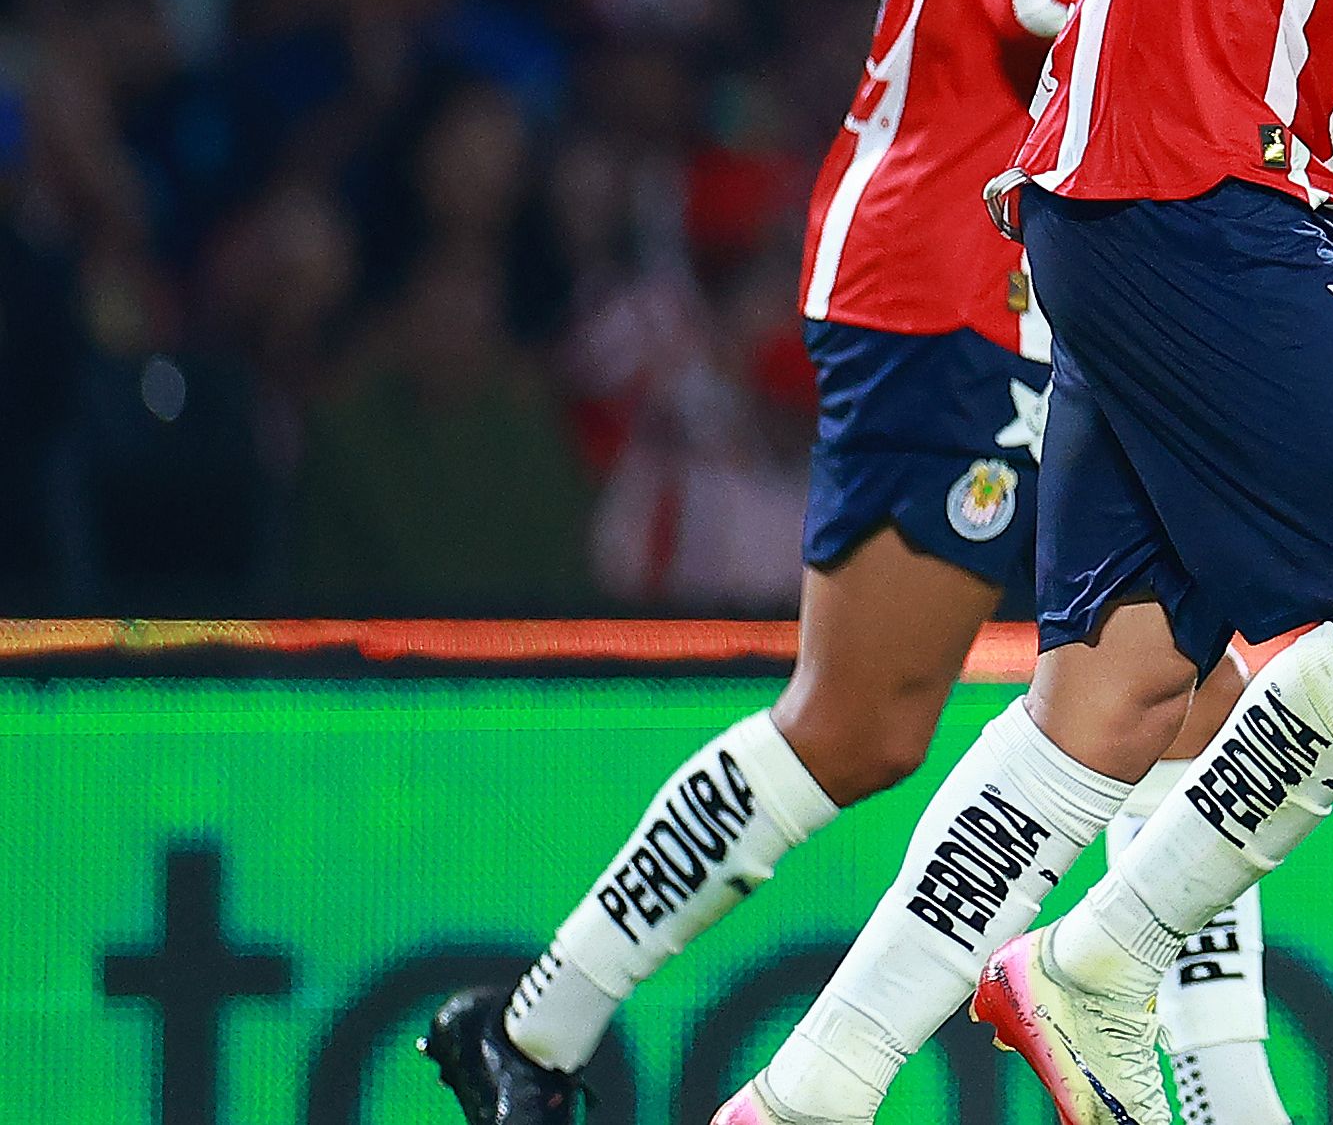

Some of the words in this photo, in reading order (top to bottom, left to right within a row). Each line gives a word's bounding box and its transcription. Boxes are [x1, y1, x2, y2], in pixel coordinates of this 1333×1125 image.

[598, 749, 754, 944] PERDURA
[1185, 689, 1332, 849] PERDURA
[906, 789, 1051, 952] PERDURA
